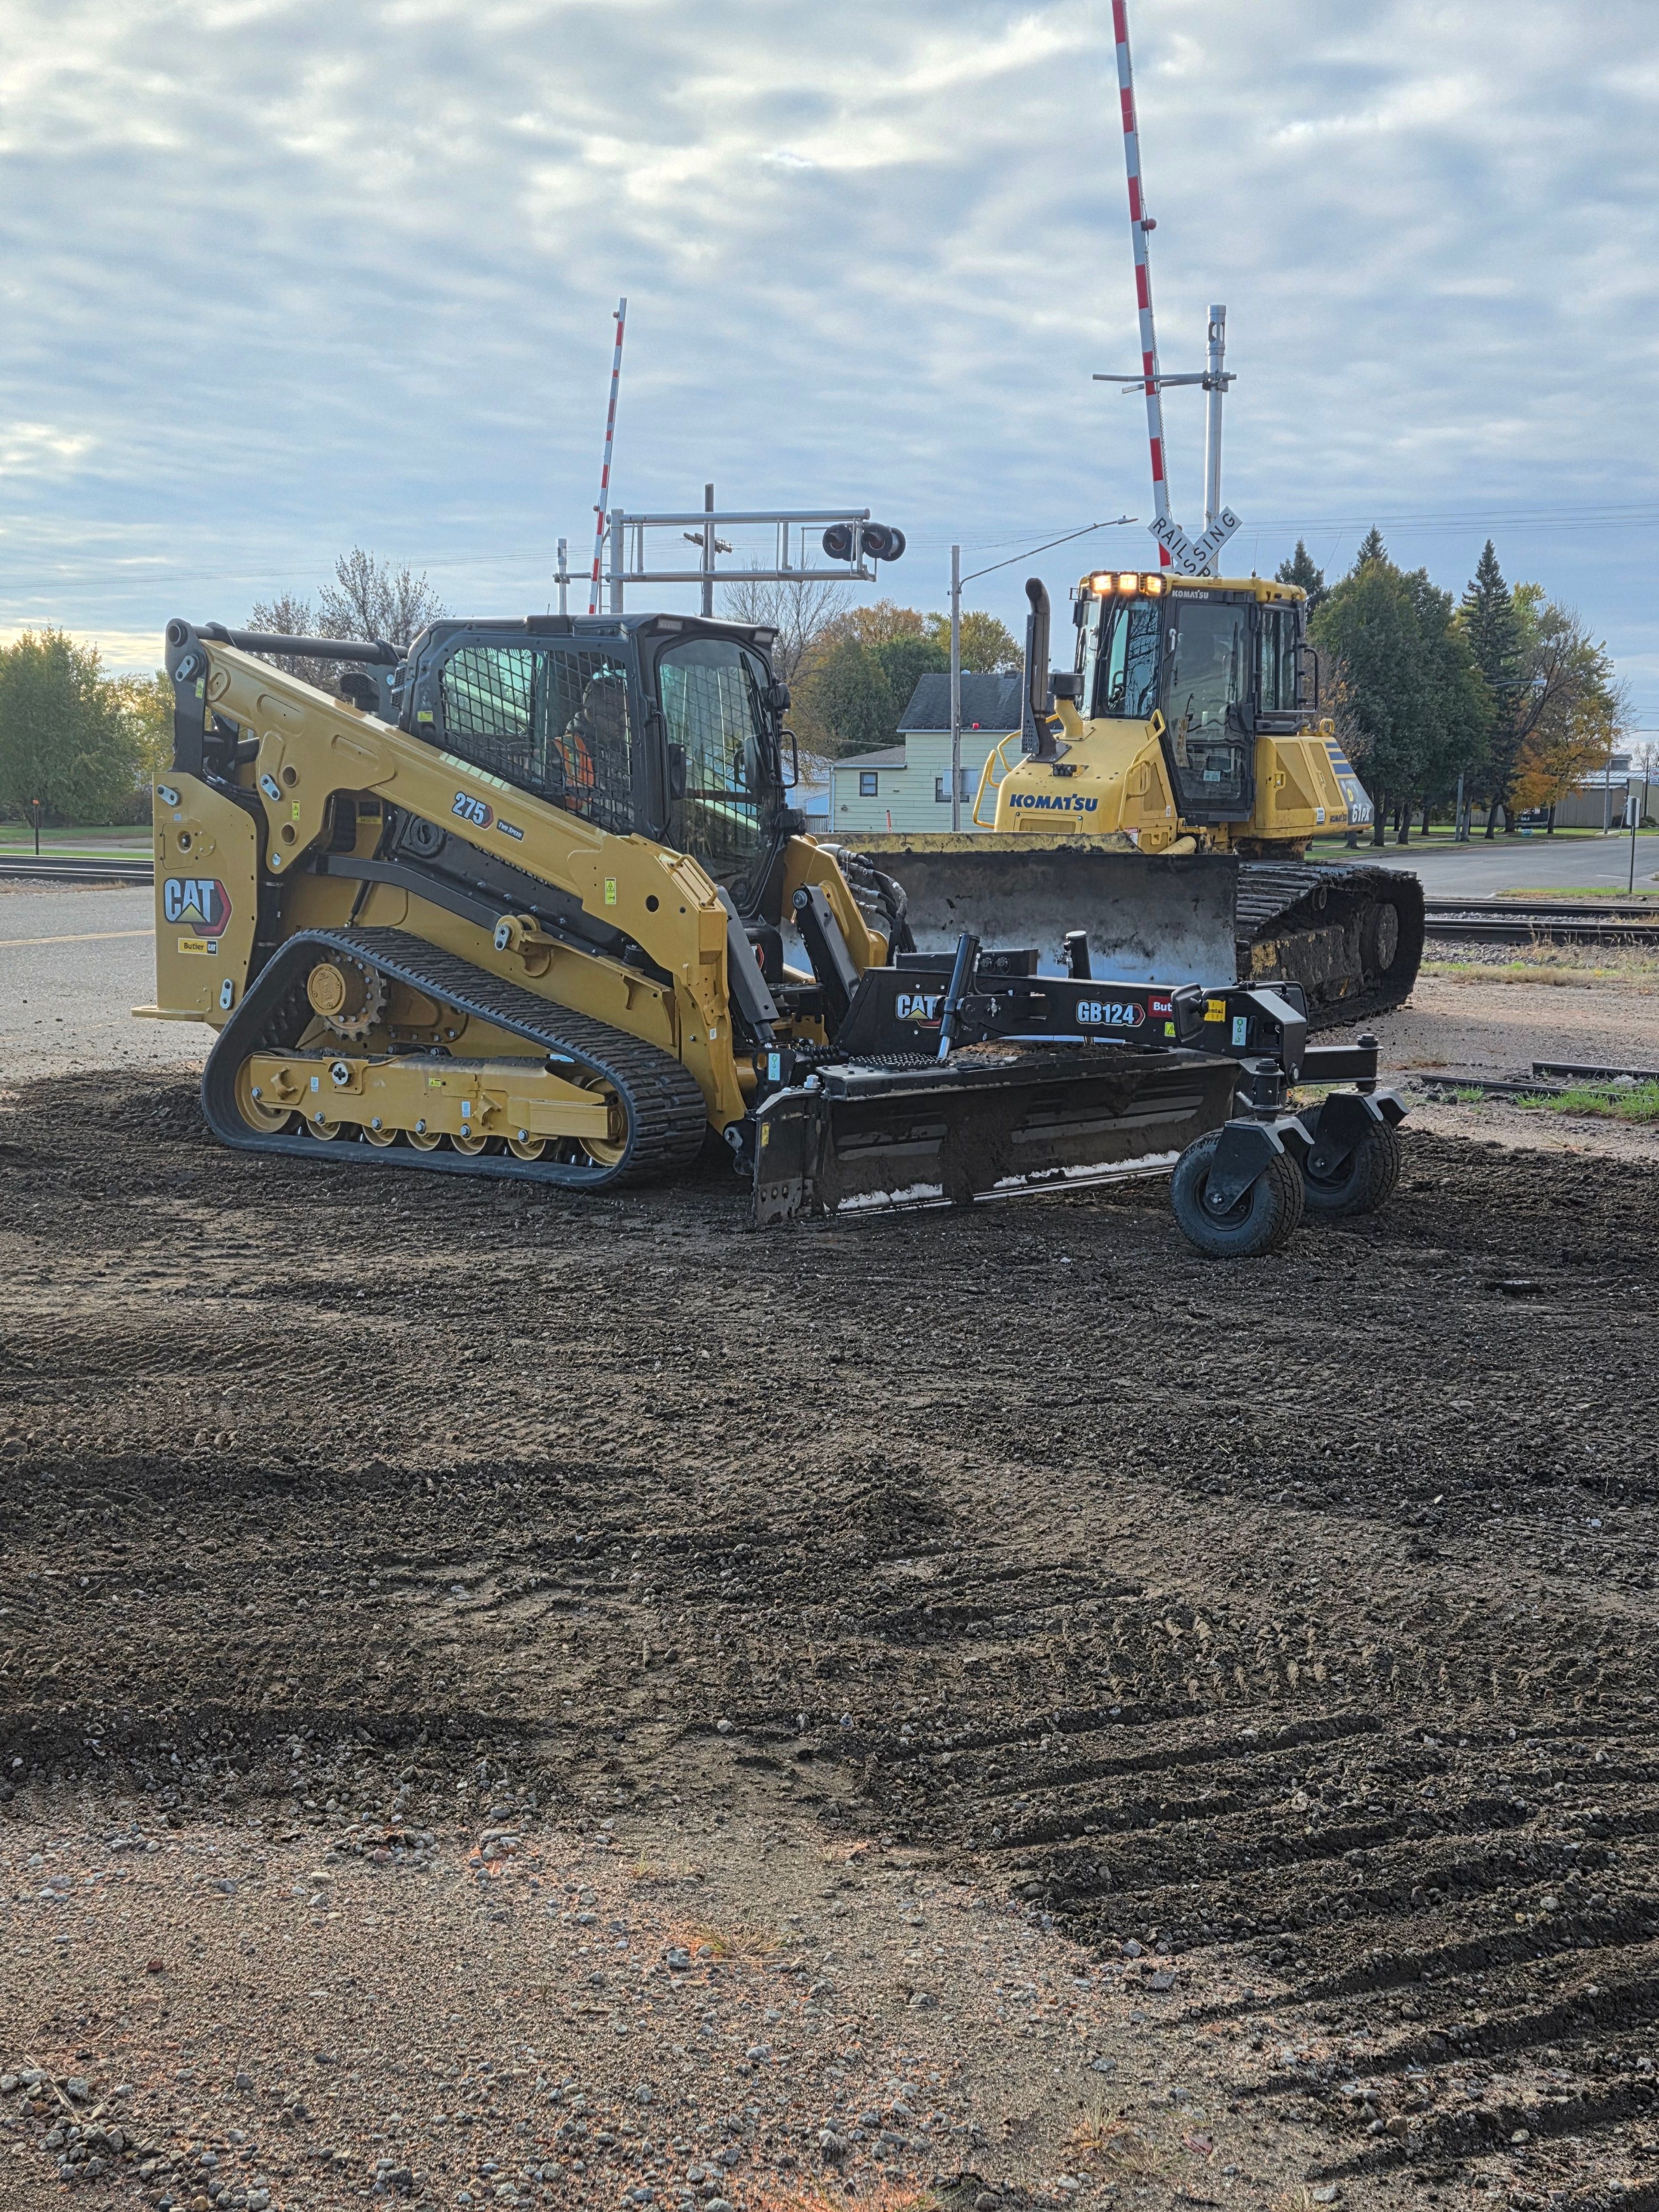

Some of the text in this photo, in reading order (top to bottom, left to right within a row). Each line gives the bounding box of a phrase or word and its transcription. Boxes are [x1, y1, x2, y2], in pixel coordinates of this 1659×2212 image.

[1153, 518, 1187, 559] RAIL
[1175, 513, 1235, 576] SSING
[1172, 589, 1209, 599] KOMATSU
[452, 792, 486, 824] 275
[1009, 794, 1098, 812] KOMATSU
[165, 879, 215, 922] CAT
[898, 994, 937, 1019] CAT
[1078, 1001, 1134, 1024] GB124
[1154, 1001, 1172, 1011] But
